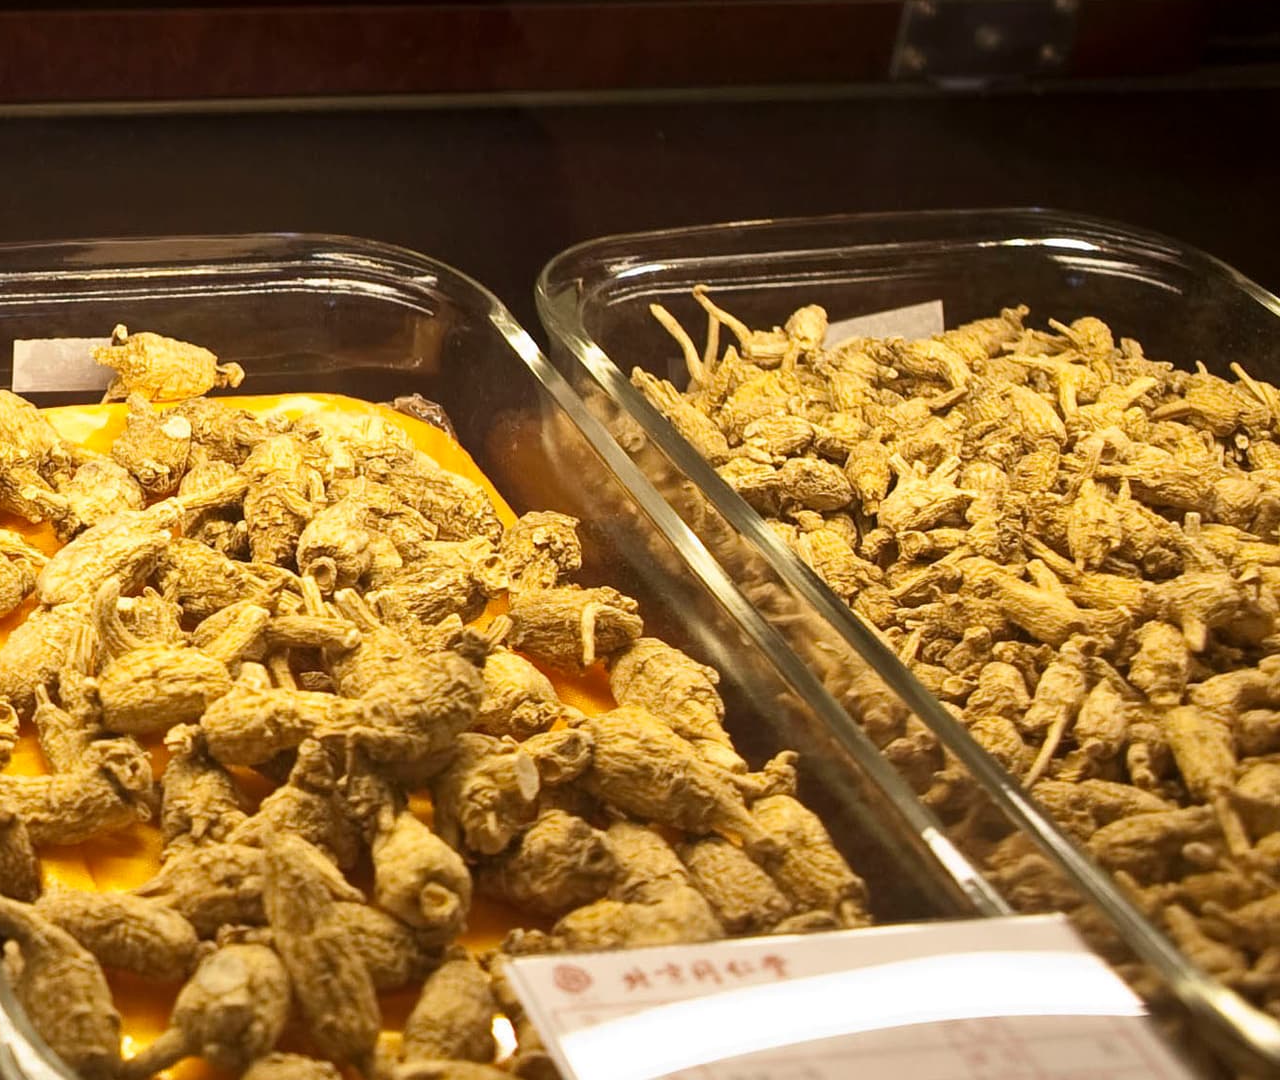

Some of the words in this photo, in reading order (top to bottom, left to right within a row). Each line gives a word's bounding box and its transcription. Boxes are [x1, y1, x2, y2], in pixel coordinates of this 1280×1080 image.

[622, 954, 788, 990] 北京同仁堂
